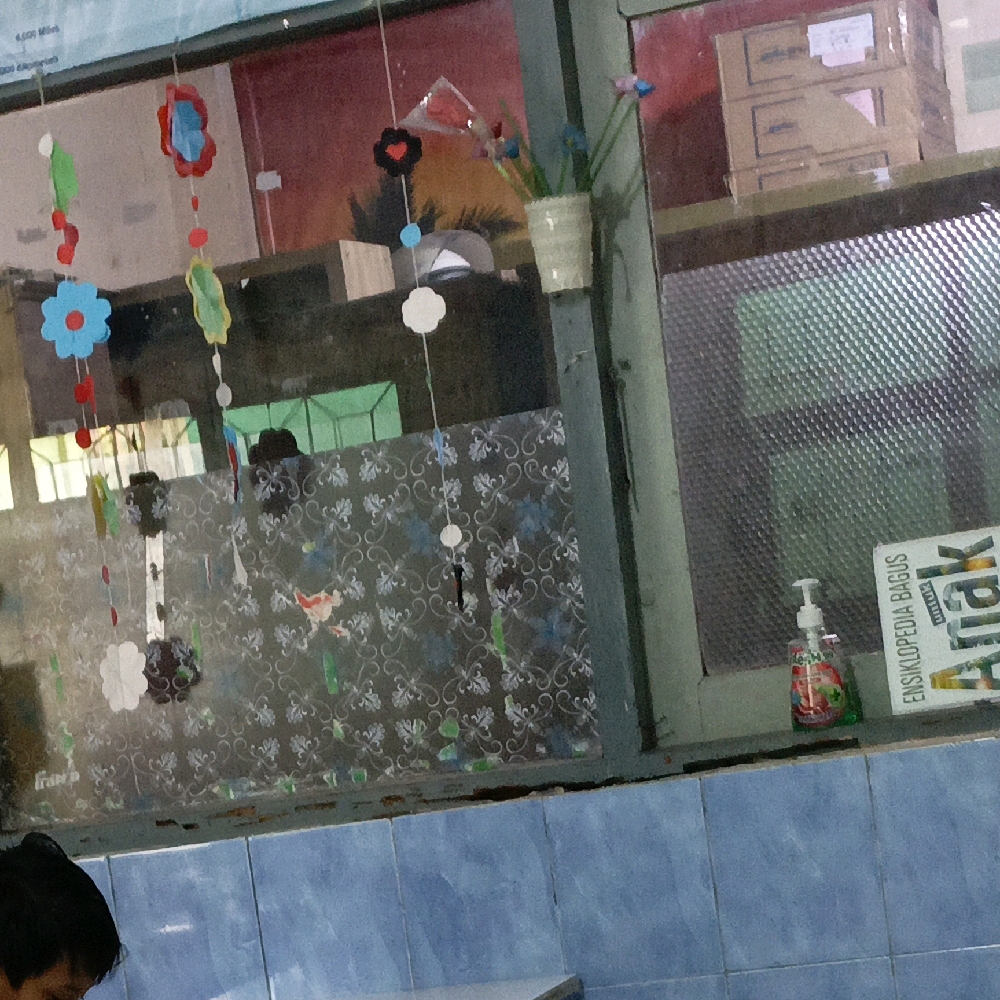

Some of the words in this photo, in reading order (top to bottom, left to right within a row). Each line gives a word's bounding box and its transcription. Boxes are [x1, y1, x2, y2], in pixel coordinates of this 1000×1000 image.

[884, 552, 913, 603] BAGUS
[915, 535, 1000, 690] Anak
[890, 605, 926, 704] ENSIKLOPEDIA
